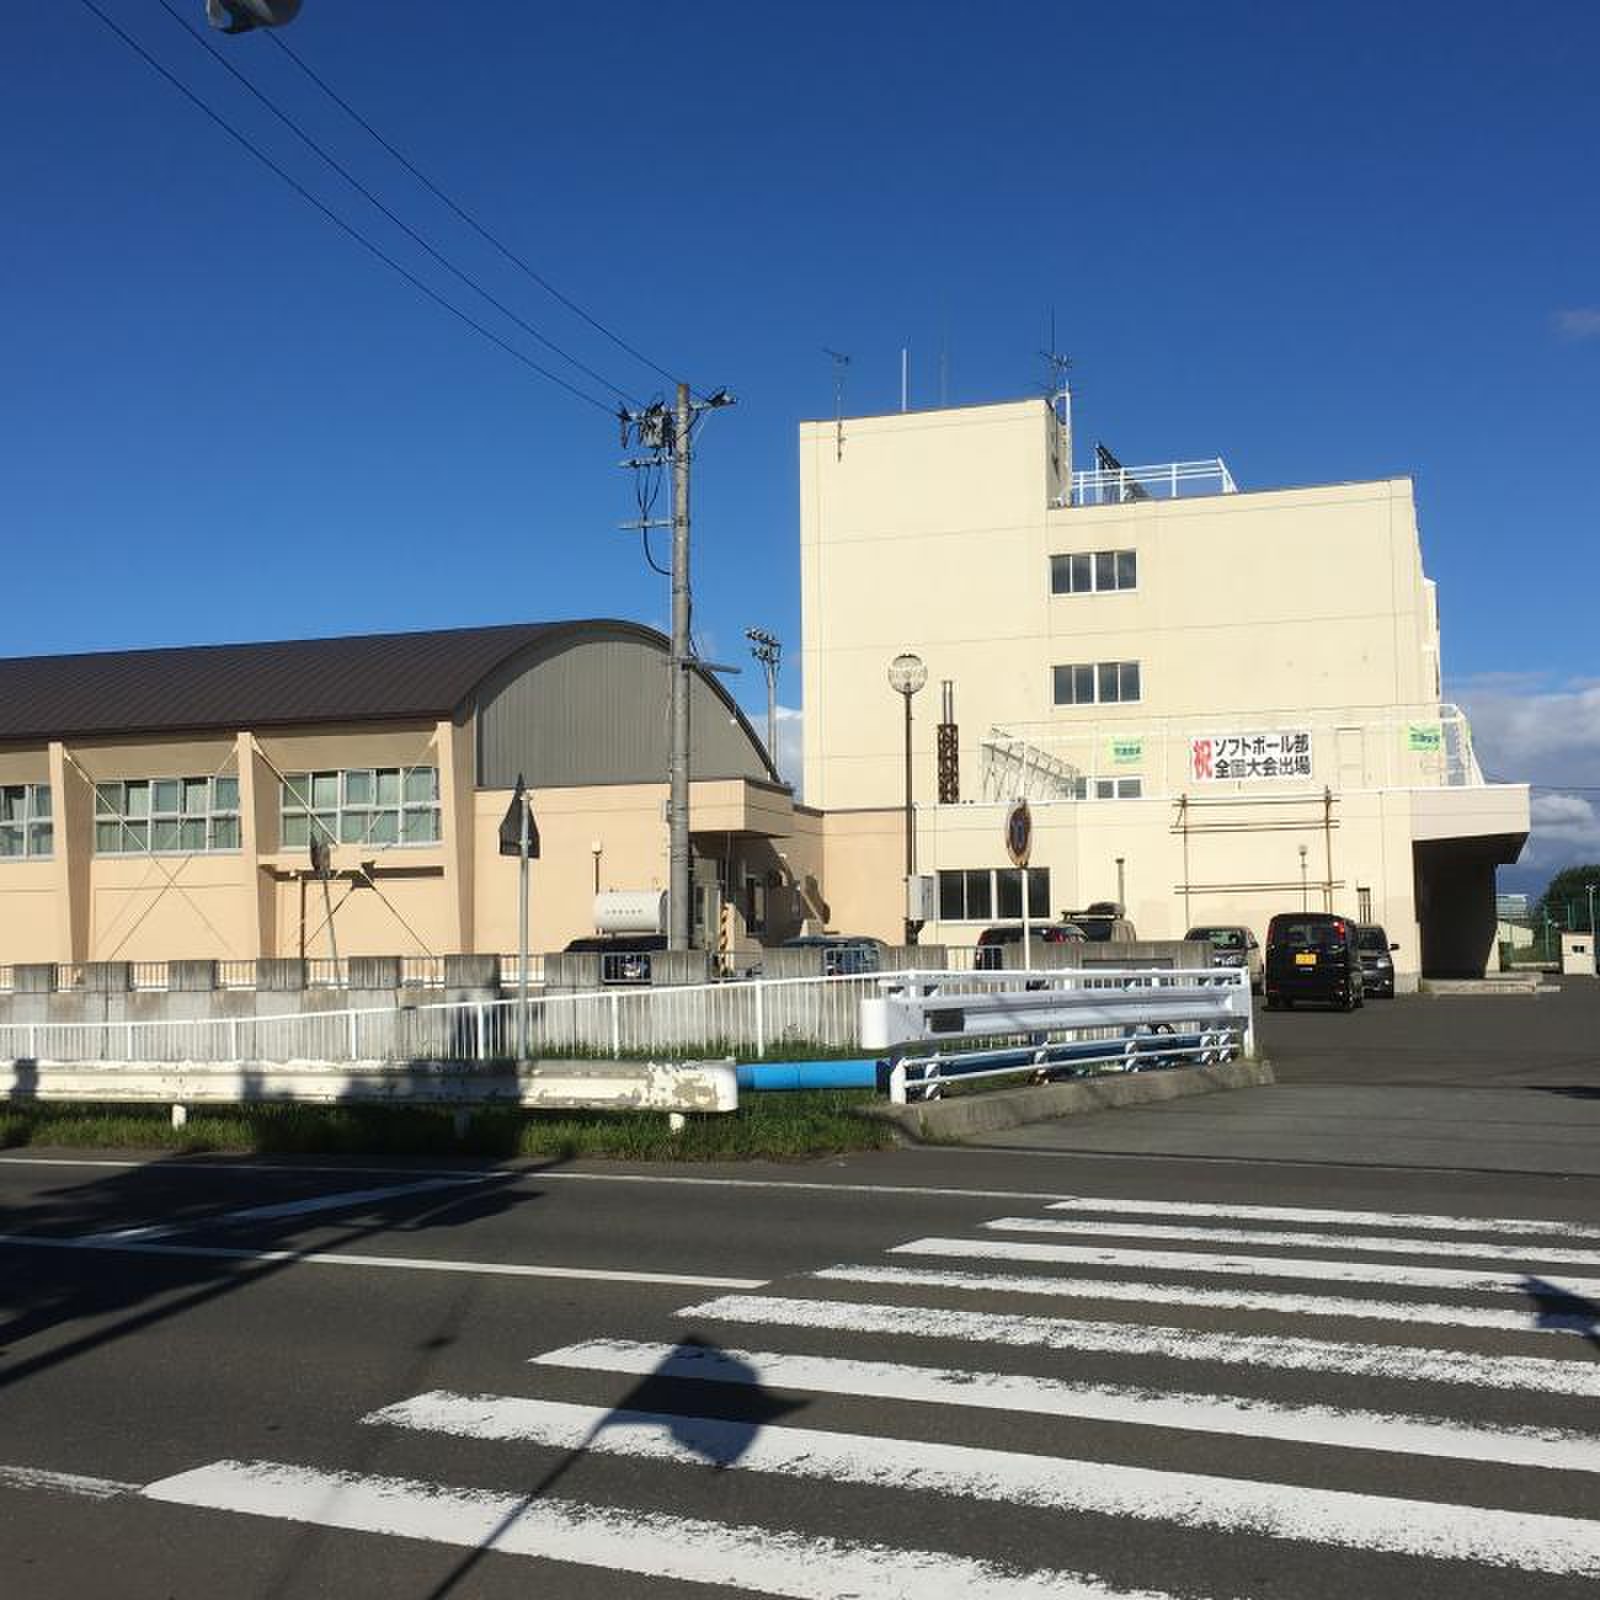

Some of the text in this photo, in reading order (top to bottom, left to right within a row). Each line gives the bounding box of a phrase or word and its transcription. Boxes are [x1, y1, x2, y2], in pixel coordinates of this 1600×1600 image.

[1215, 734, 1309, 756] ソフトボール部
[1193, 740, 1212, 780] 祝
[1215, 756, 1311, 779] 全国大会出場
